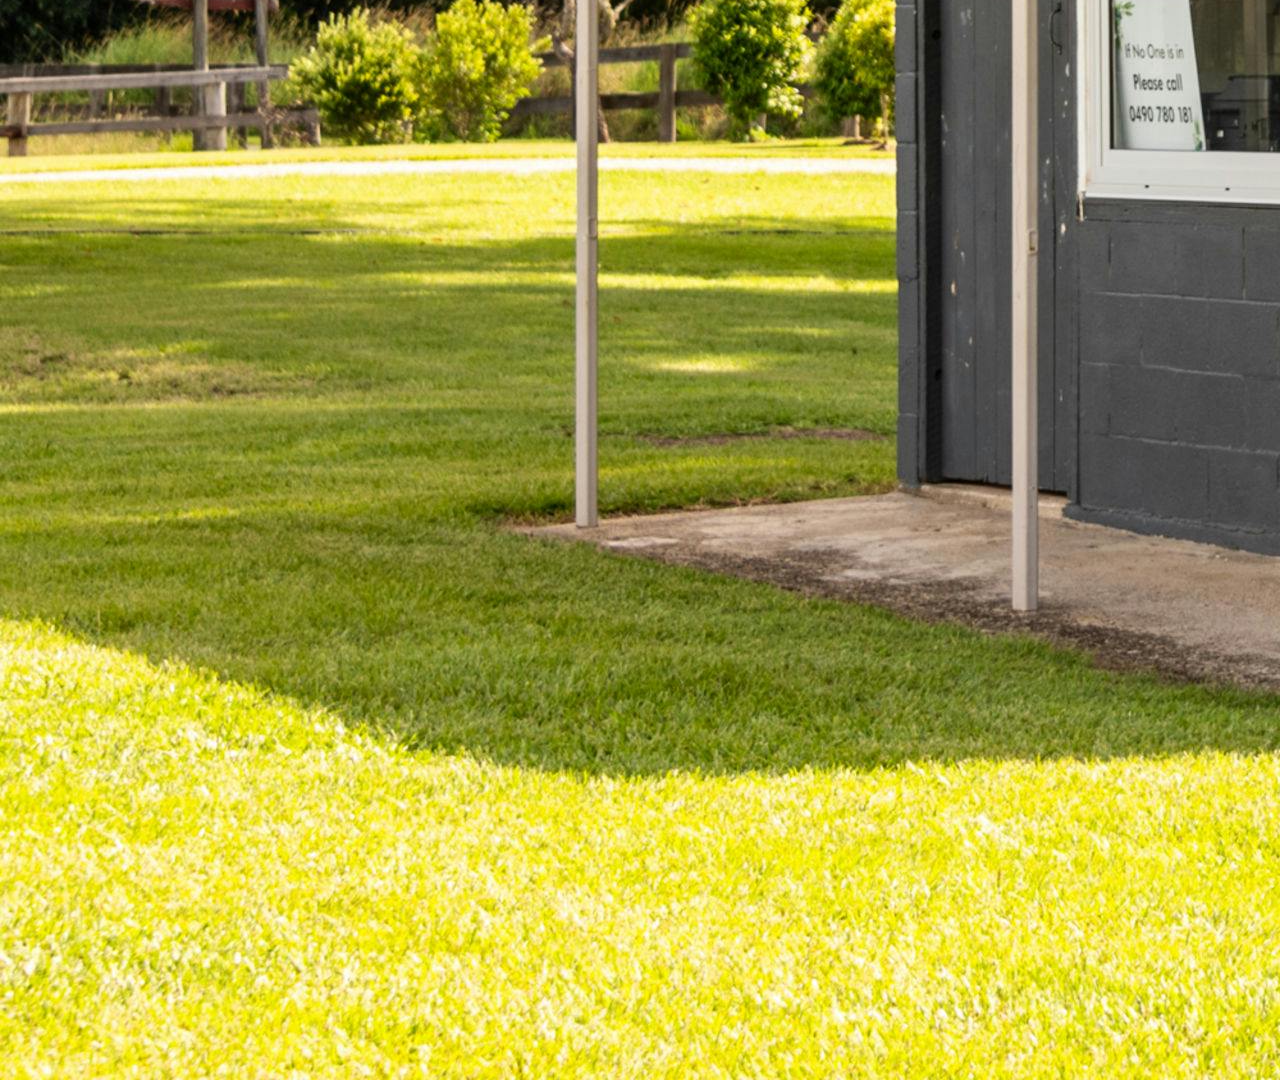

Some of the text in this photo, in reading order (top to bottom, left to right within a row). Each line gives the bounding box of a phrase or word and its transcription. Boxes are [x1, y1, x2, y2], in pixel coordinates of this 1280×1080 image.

[1125, 43, 1184, 59] If No One is in
[1133, 73, 1183, 91] Please call
[1129, 105, 1193, 124] 0490 780 181
